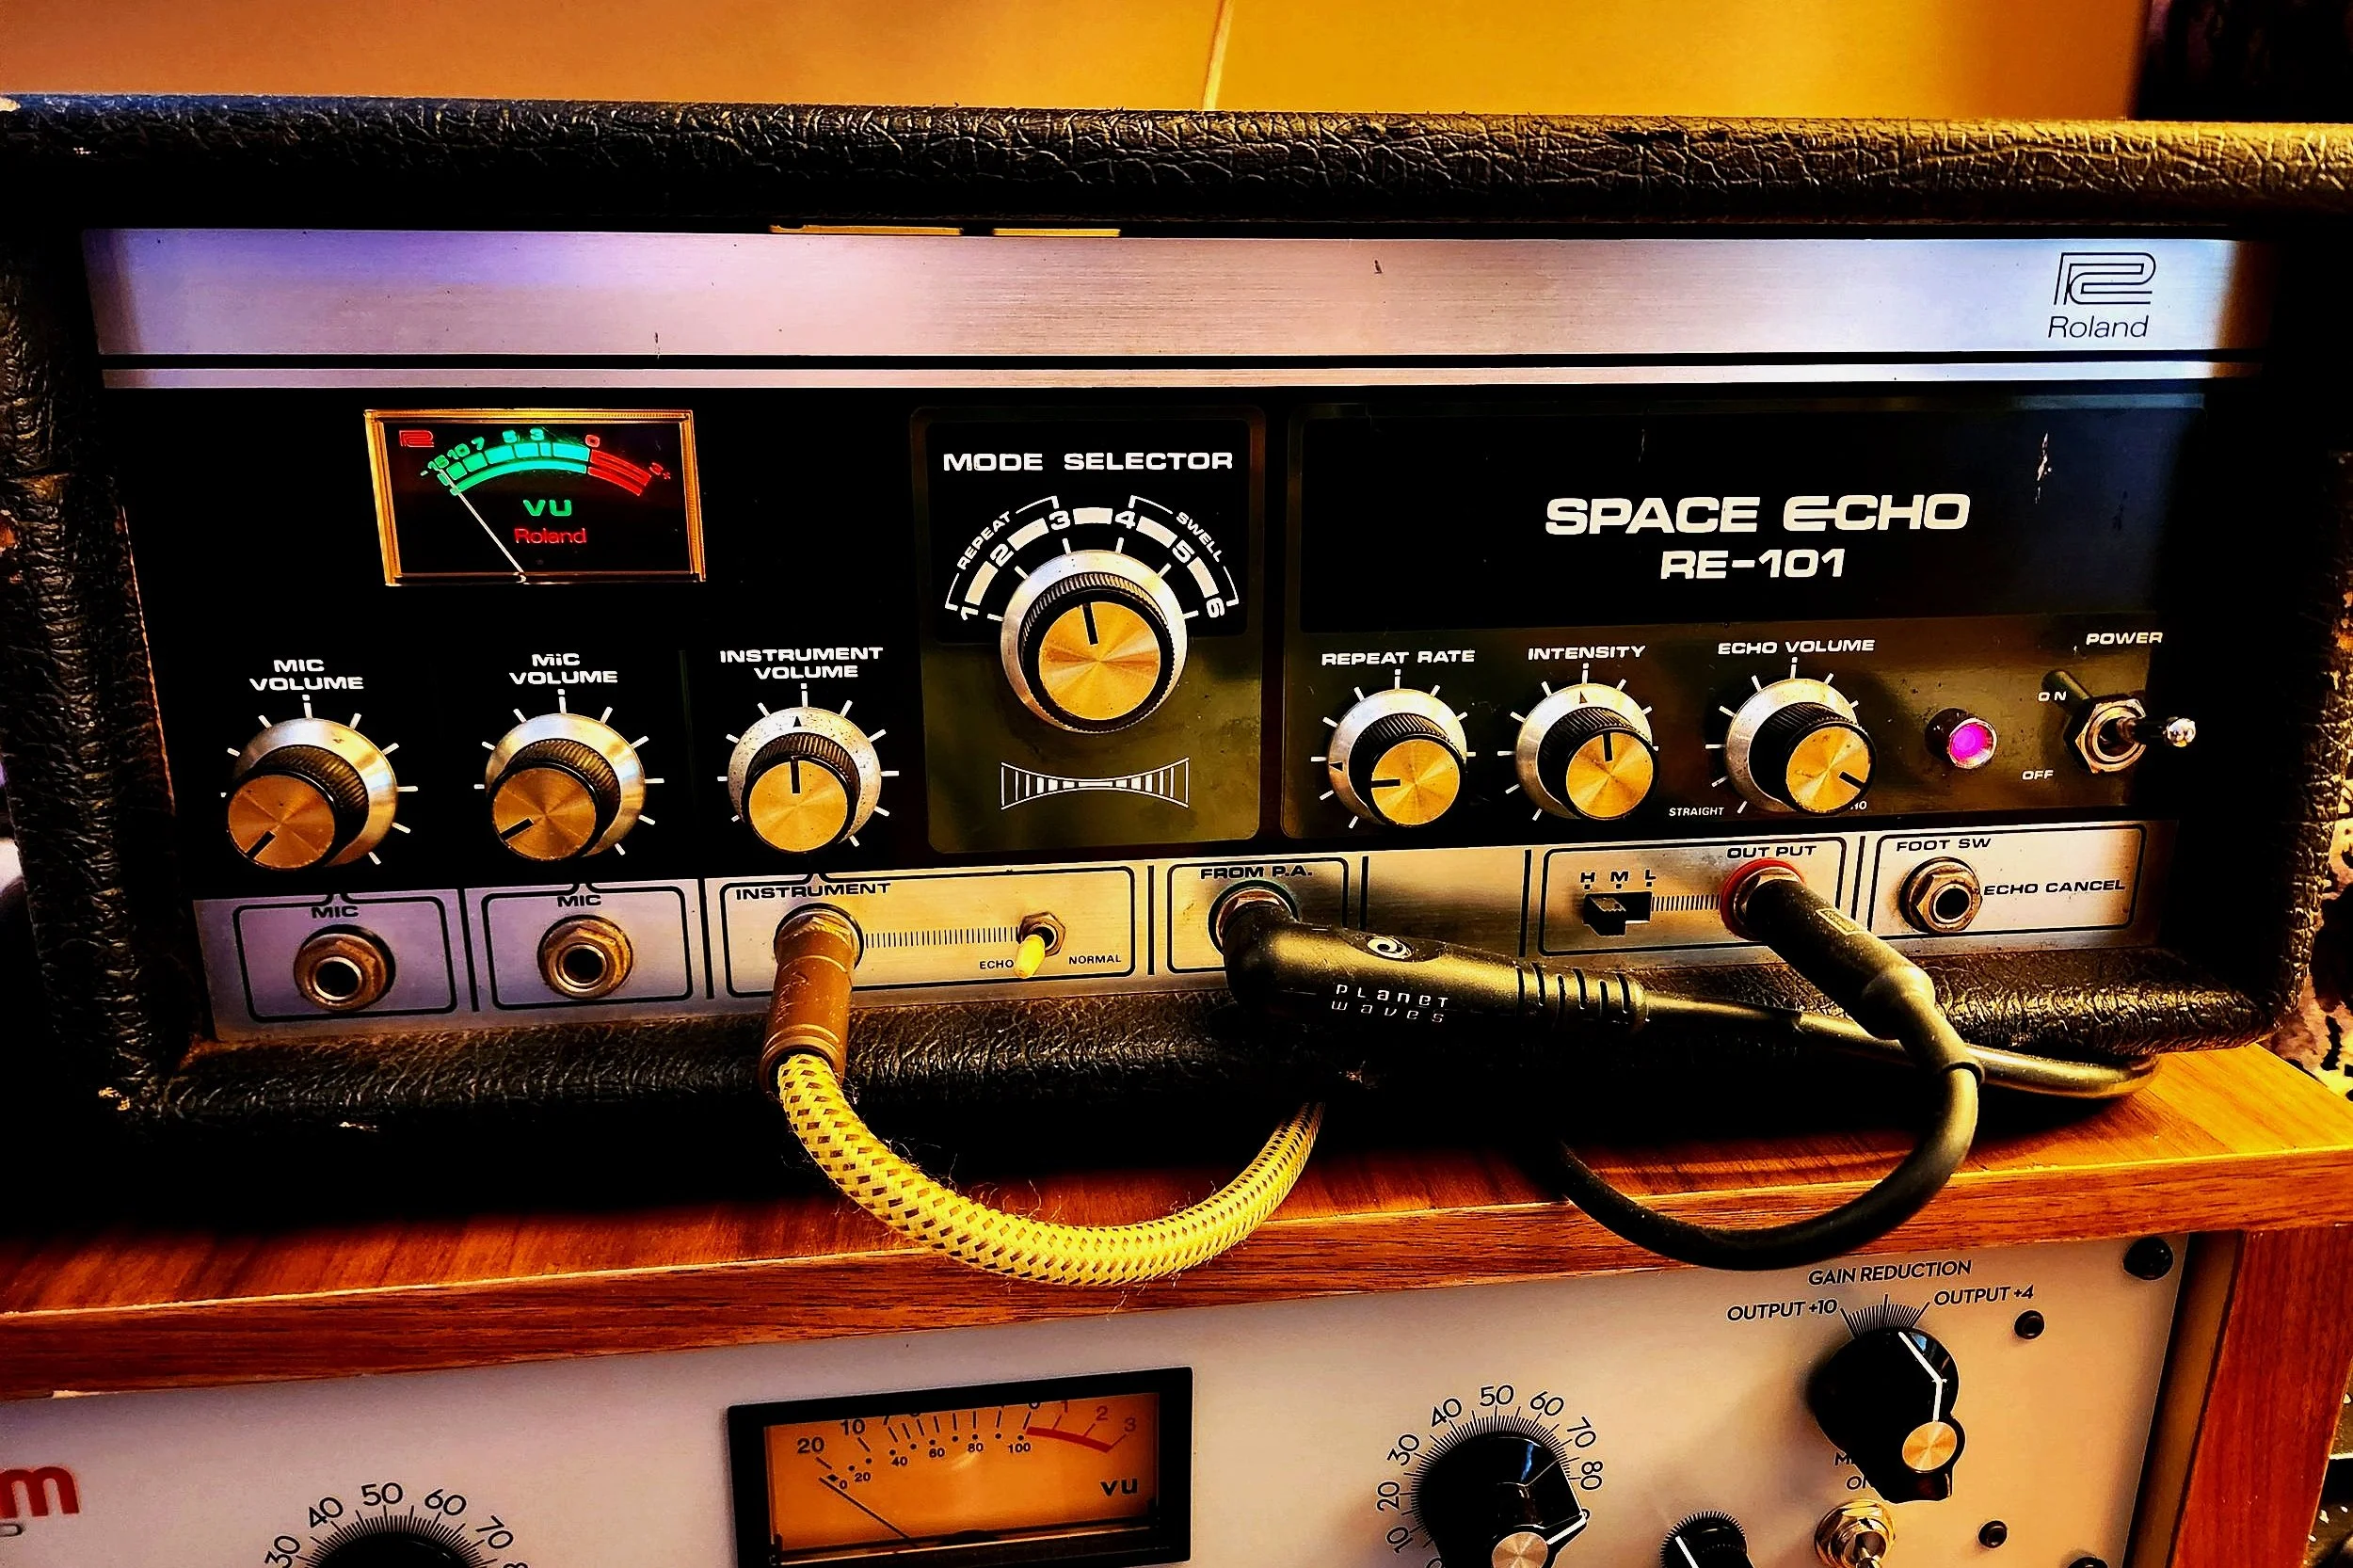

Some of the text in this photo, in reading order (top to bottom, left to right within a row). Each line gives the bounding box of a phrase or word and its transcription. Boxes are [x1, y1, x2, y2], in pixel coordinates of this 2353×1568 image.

[2048, 315, 2149, 338] Roland
[447, 443, 470, 459] 10
[472, 437, 485, 450] 7
[530, 428, 544, 440] 3
[585, 435, 600, 447] 0
[943, 452, 1233, 472] MODE SELECTOR
[523, 500, 572, 517] VU
[1545, 493, 1970, 535] SPACE ECHO
[515, 528, 586, 544] Roland
[957, 511, 1011, 570] REPEAT
[1176, 512, 1224, 562] SWELL
[961, 510, 1225, 621] 1 2 3 4 5 6
[1660, 549, 1845, 580] RE-101
[1718, 639, 1876, 655] ECHO VOLUME
[2086, 632, 2164, 646] POWER
[720, 647, 884, 663] INSTRUMENT
[1321, 649, 1476, 666] REPEAT RATE
[1528, 645, 1646, 660] INTENSITY
[273, 659, 325, 673] MIC
[754, 665, 858, 680] VOLUME
[249, 676, 364, 692] VOLUME
[509, 671, 618, 684] VOLUME
[2038, 691, 2067, 701] ON
[2022, 769, 2054, 780] OFF
[1669, 807, 1724, 817] STRAIGHT
[1727, 846, 1817, 858] OUT PUT
[1896, 838, 1992, 852] FOOT SW
[1200, 864, 1313, 880] FROM P.A.
[1580, 870, 1657, 883] H M L
[735, 883, 891, 900] INSTRUMENT
[1983, 879, 2126, 895] ECHO CANCEL
[557, 893, 601, 908] MIC
[311, 904, 359, 919] MIC
[979, 958, 1015, 970] ECHO
[1068, 953, 1122, 966] NORMAL
[1331, 1000, 1445, 1023] waves
[1809, 1259, 1972, 1286] GAIN REDUCTION
[1933, 1285, 2034, 1306] OUTPUT +4
[1727, 1299, 1837, 1321] OUTPUT +10
[797, 1436, 824, 1453] 20
[840, 1419, 865, 1435] 10
[1096, 1406, 1109, 1421] 2
[1125, 1417, 1137, 1432] 3
[855, 1472, 871, 1482] 20
[891, 1457, 907, 1467] 40
[968, 1443, 984, 1452] 80
[1008, 1443, 1032, 1453] 100
[1377, 1384, 1603, 1553] 10 20 30 40 50 60 70 80
[264, 1482, 514, 1568] 30 40 50 60 70
